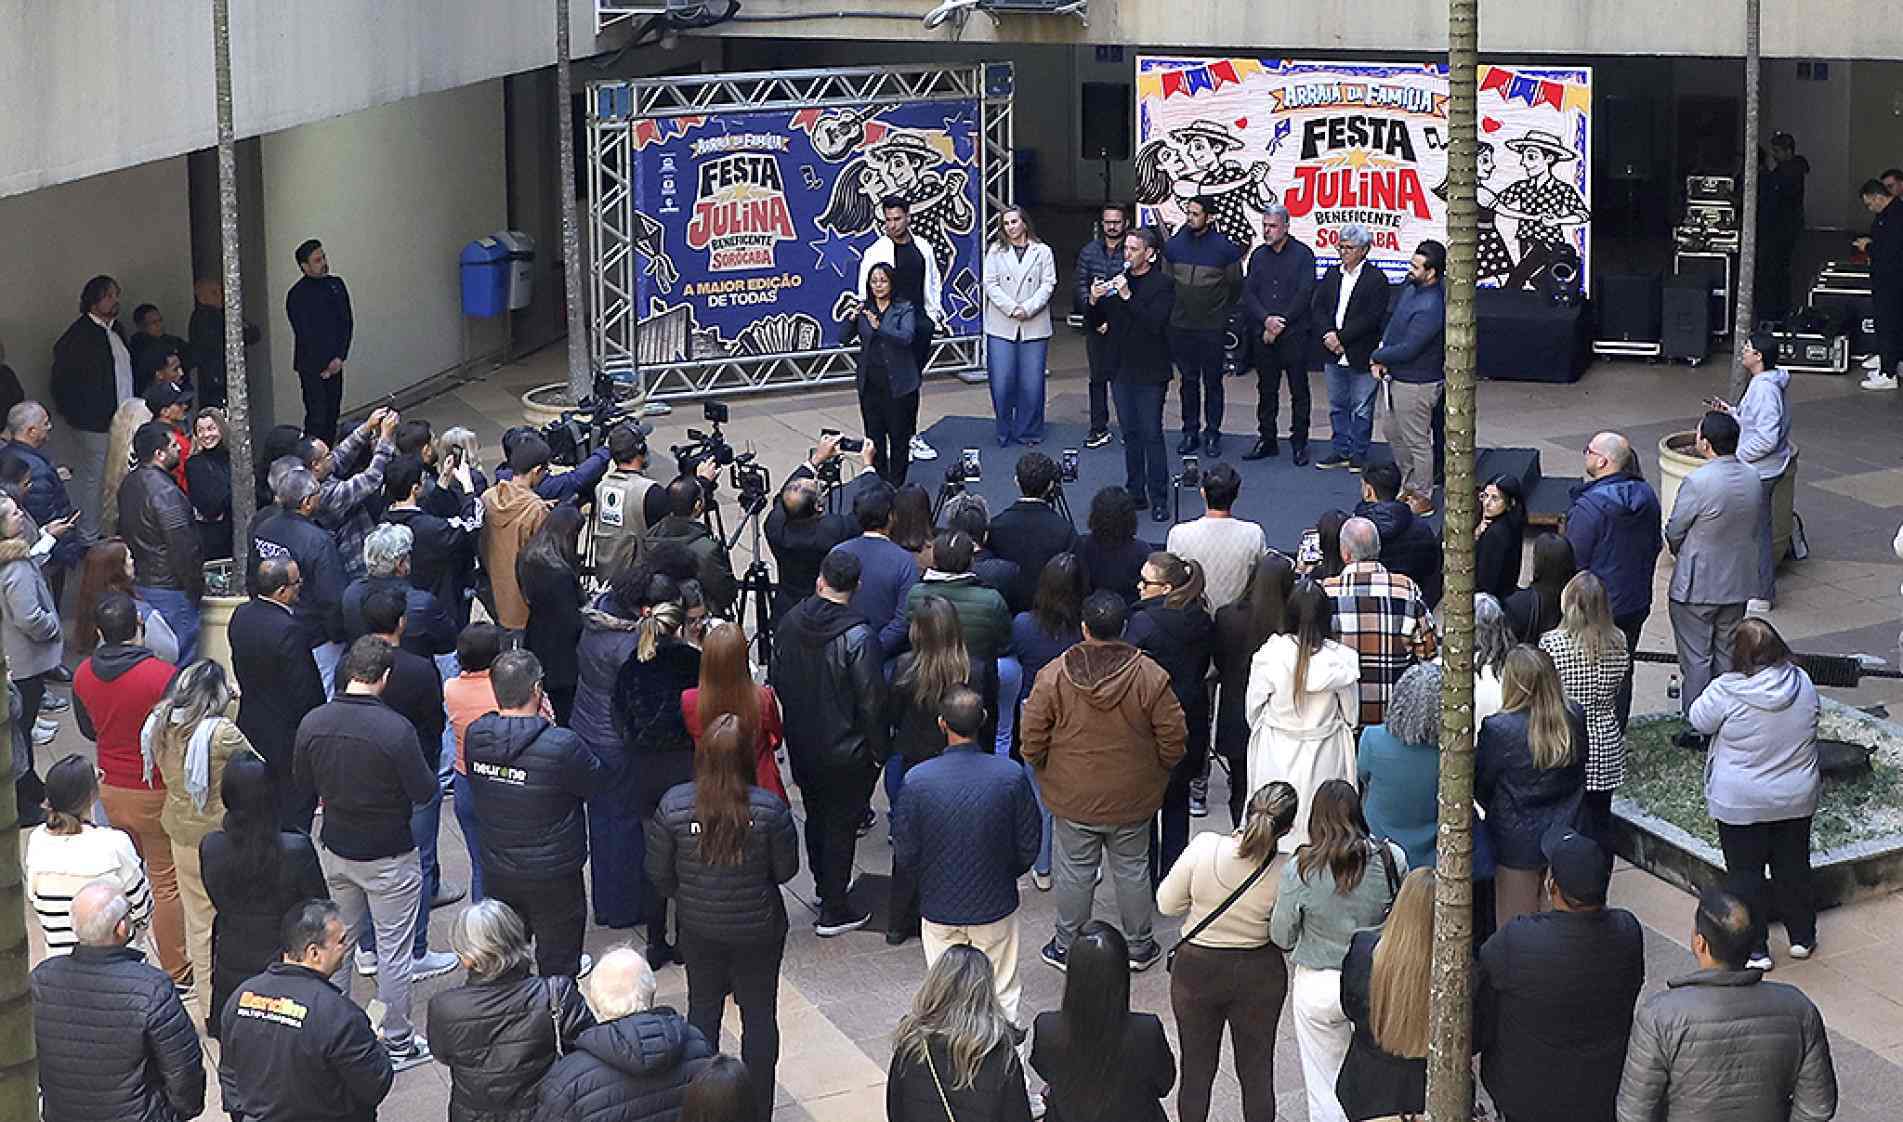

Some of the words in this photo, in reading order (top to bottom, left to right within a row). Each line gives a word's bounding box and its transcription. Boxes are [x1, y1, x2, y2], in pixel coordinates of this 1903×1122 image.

[1301, 115, 1416, 161] FESTA
[700, 157, 781, 198] FESTA
[1315, 210, 1401, 227] BENEFICENTE
[684, 283, 695, 296] A
[696, 281, 745, 295] MAIOR
[747, 273, 802, 291] EDIÇÃO
[708, 294, 728, 308] DE
[729, 290, 778, 305] TODAS
